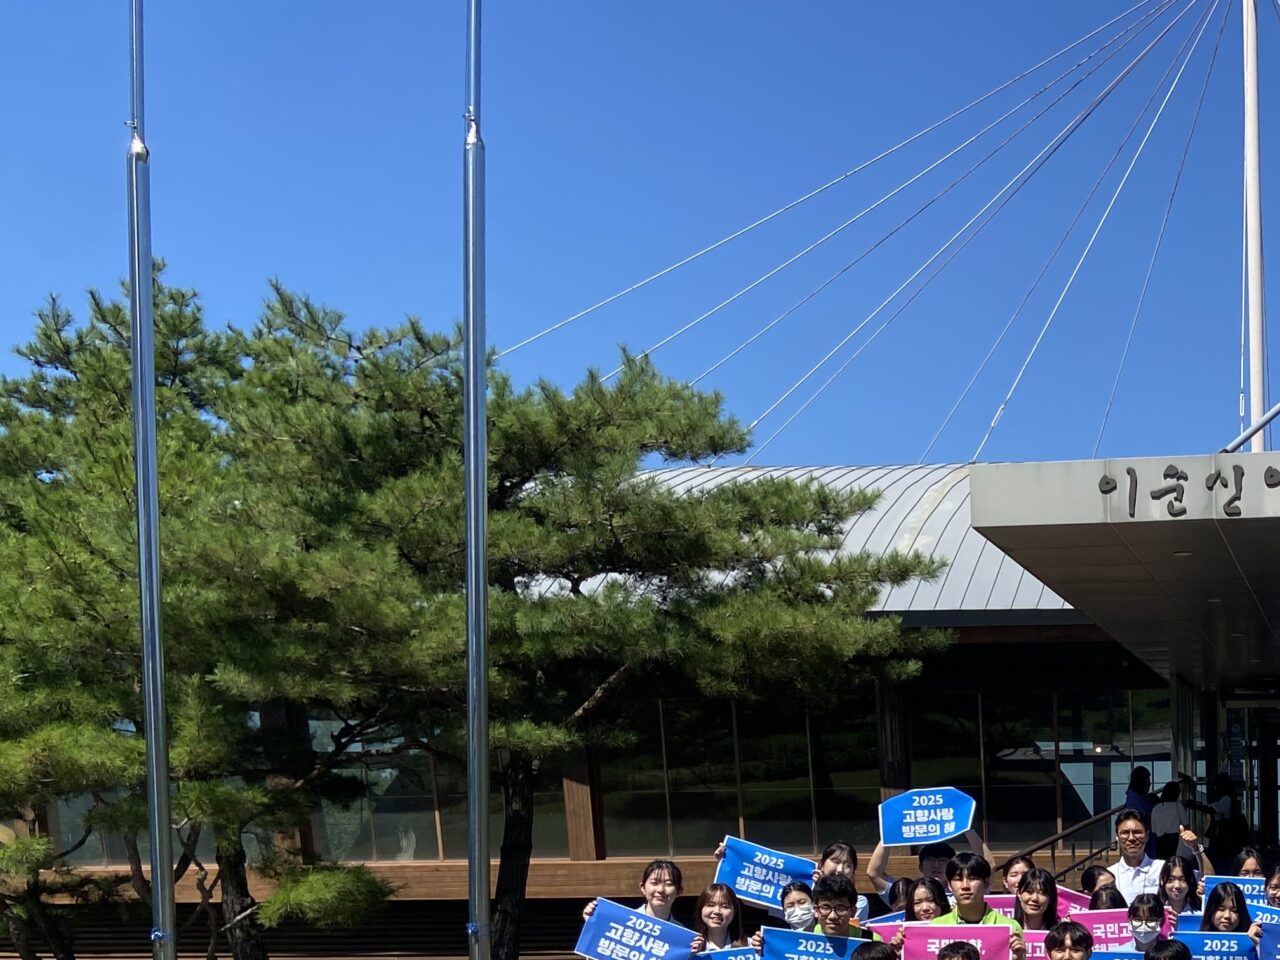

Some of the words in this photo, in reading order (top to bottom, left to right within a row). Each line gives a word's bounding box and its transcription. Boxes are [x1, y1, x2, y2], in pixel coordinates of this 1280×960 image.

[912, 795, 943, 807] 2025
[902, 808, 954, 823] 고향사랑
[902, 824, 941, 838] 방문의
[943, 821, 956, 834] 해
[753, 852, 785, 869] 2025
[740, 862, 792, 886] 고향사랑
[735, 876, 775, 898] 방문의
[626, 916, 662, 936] 2025
[605, 922, 669, 956] 고향사랑
[797, 939, 834, 954] 2025
[1204, 940, 1238, 952] 2025
